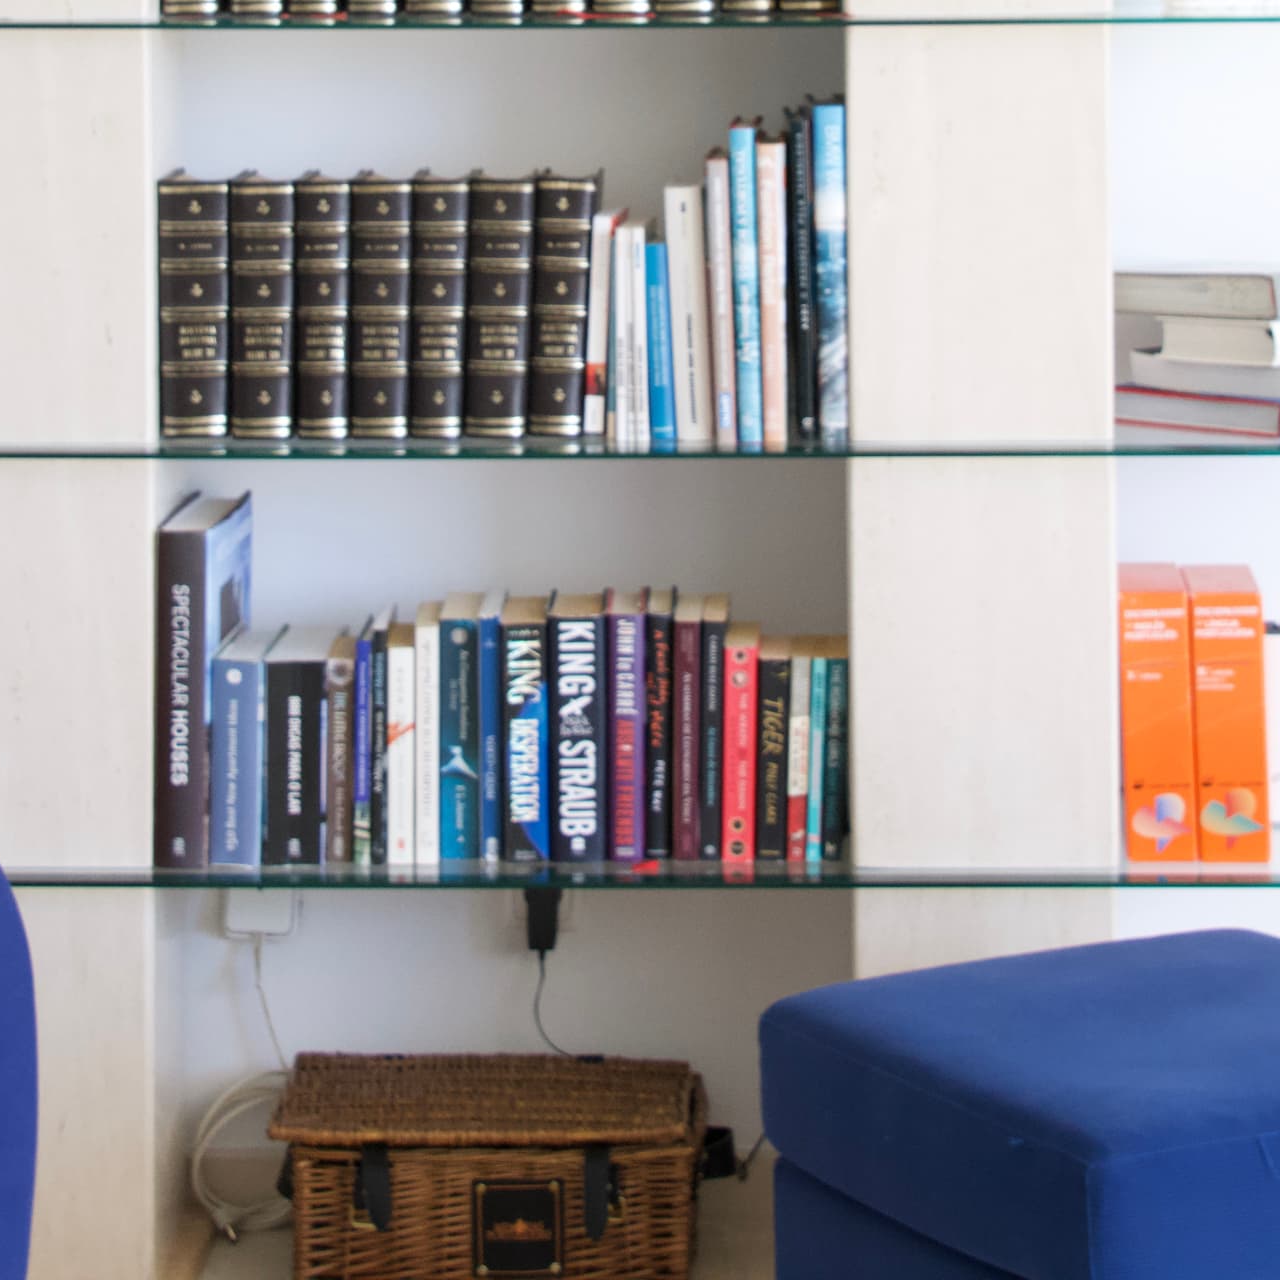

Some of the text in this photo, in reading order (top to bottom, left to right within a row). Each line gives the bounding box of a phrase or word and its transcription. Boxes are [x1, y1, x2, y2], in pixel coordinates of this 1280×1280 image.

[558, 621, 596, 696] KING
[616, 619, 635, 655] JOHN
[170, 584, 190, 787] SPECTACULAR HOUSES
[507, 640, 541, 704] KING
[616, 673, 640, 715] CARRÉ
[510, 718, 539, 824] DESPERATION
[616, 720, 634, 781] ABSOLUTE
[762, 696, 785, 825] TIGER POLLY CLARK
[559, 740, 596, 836] STRAUB
[616, 785, 634, 846] FRIENDS
[652, 760, 666, 813] PETE WAY
